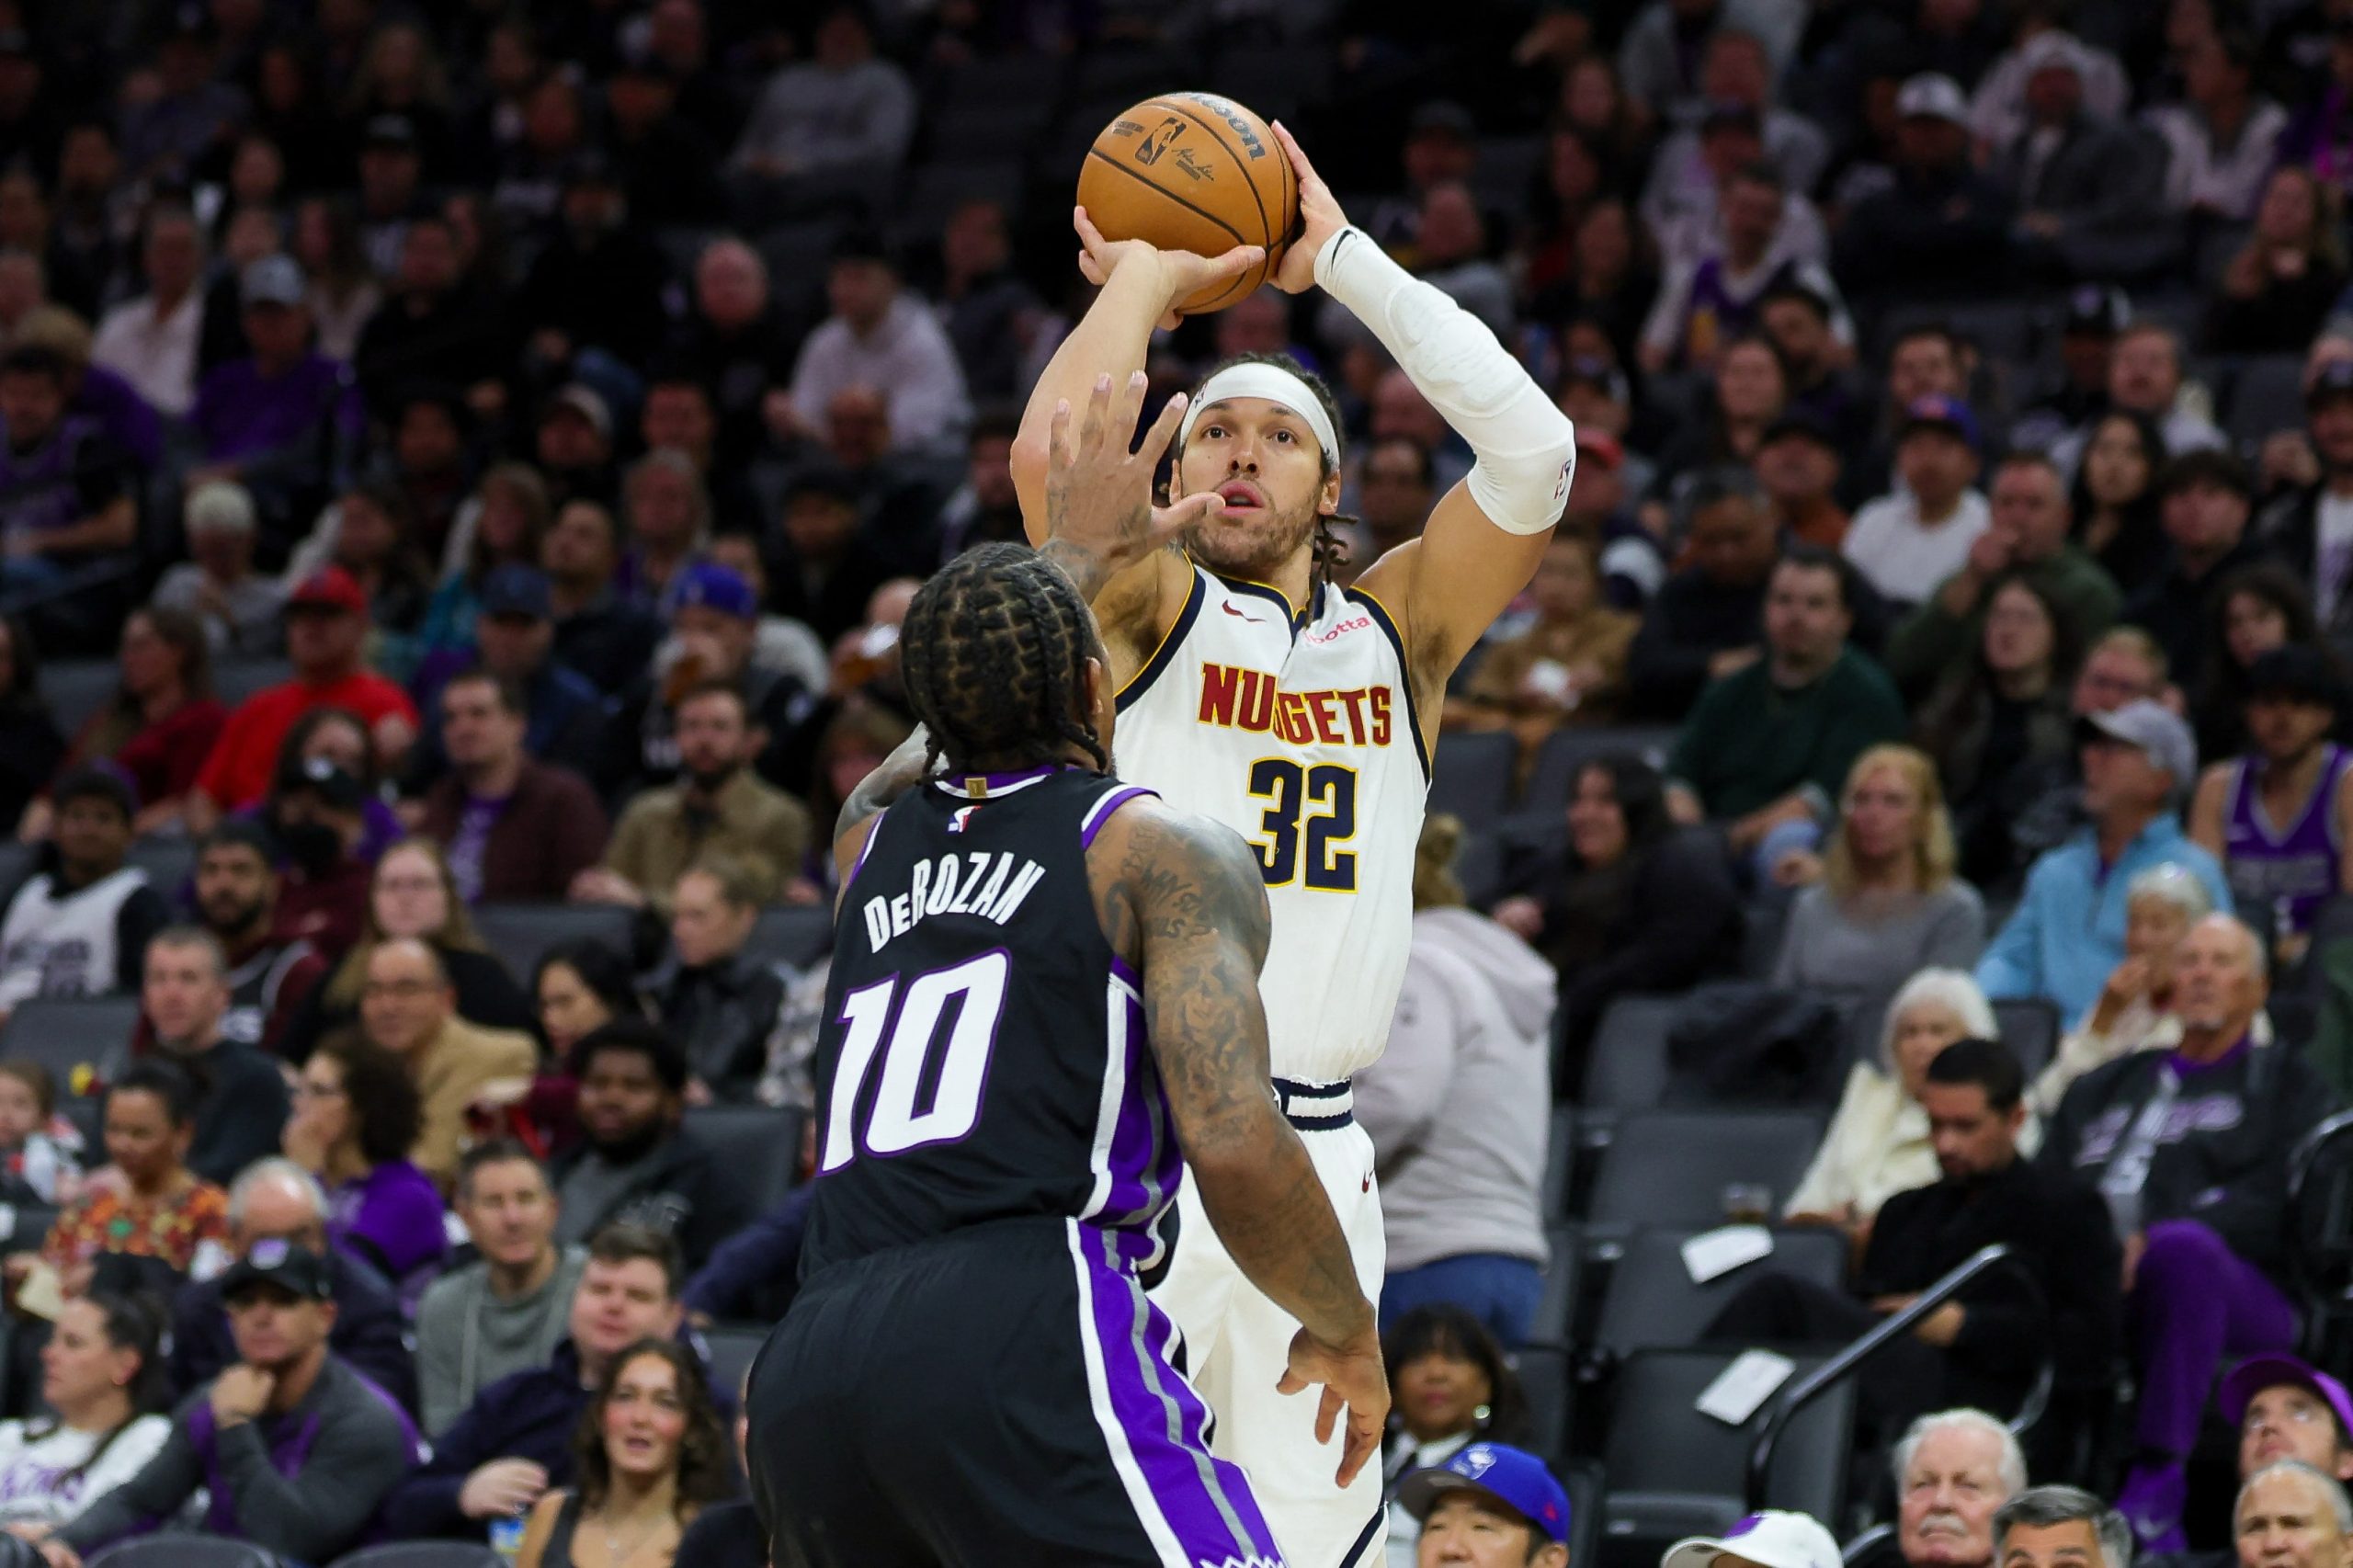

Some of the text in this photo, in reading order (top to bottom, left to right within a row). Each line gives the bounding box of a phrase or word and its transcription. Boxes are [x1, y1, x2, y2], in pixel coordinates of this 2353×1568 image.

[1198, 661, 1392, 748] NUGETS
[1246, 756, 1359, 894] 32
[817, 946, 1012, 1177] 10
